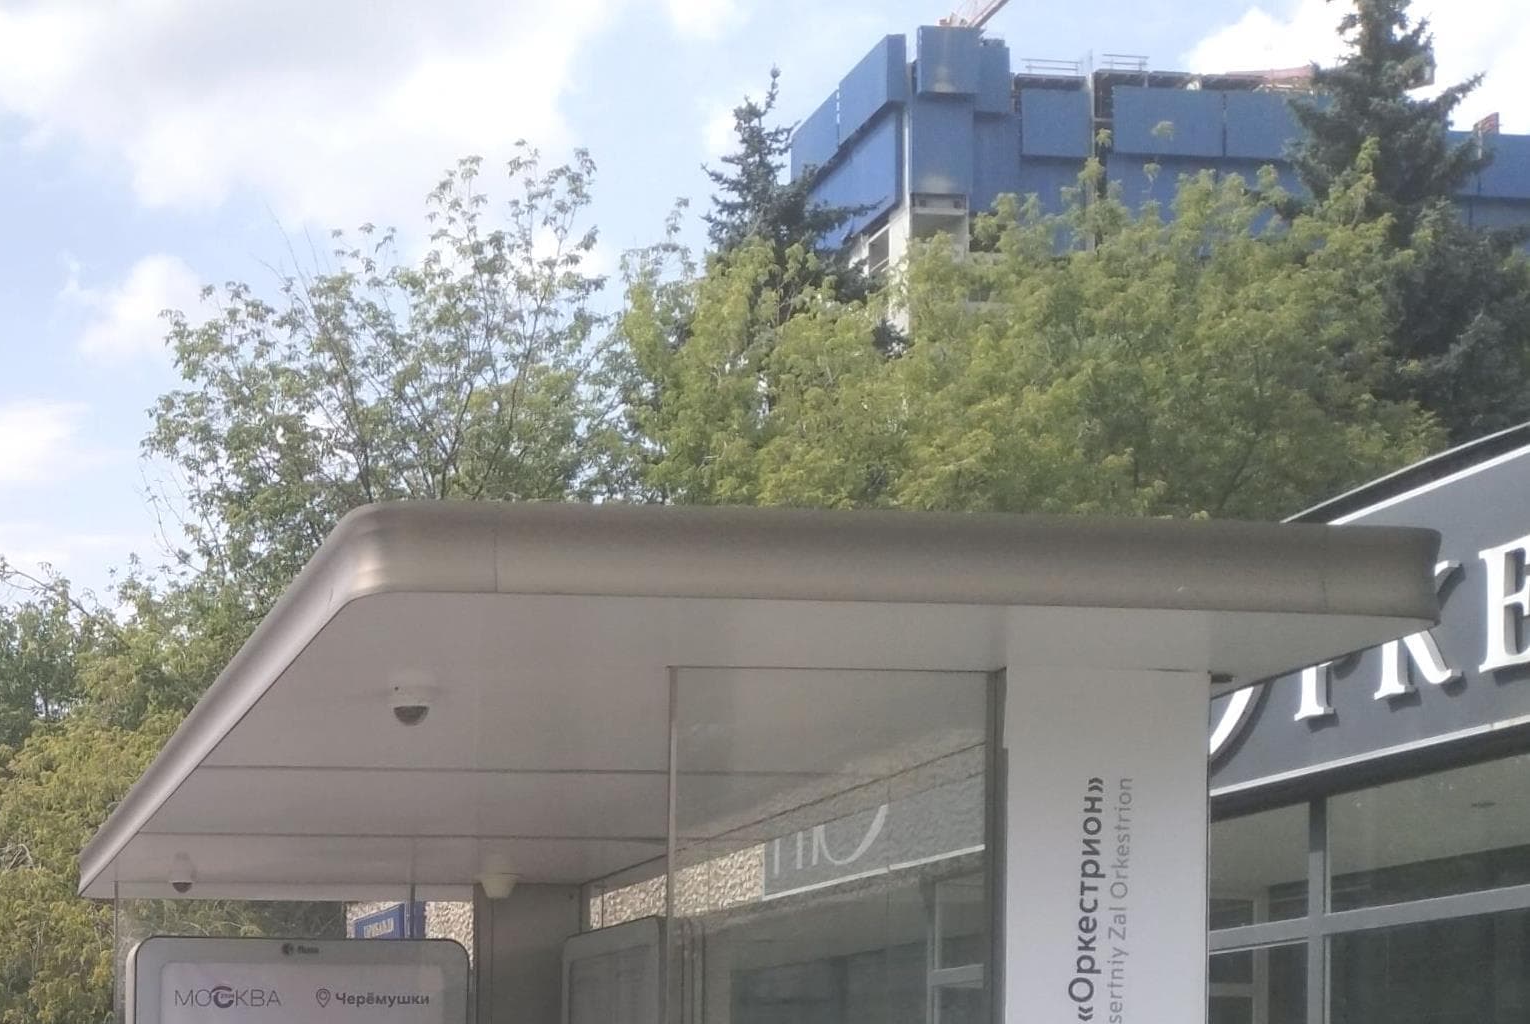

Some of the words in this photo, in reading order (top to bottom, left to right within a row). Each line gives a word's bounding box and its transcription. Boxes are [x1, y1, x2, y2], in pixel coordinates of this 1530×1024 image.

[1110, 777, 1134, 899] Orkestrion
[1068, 776, 1106, 1022] «Оркестрион»
[1108, 906, 1127, 941] Zal
[174, 985, 281, 1009] МОСКВА
[335, 991, 430, 1008] Черёмушки
